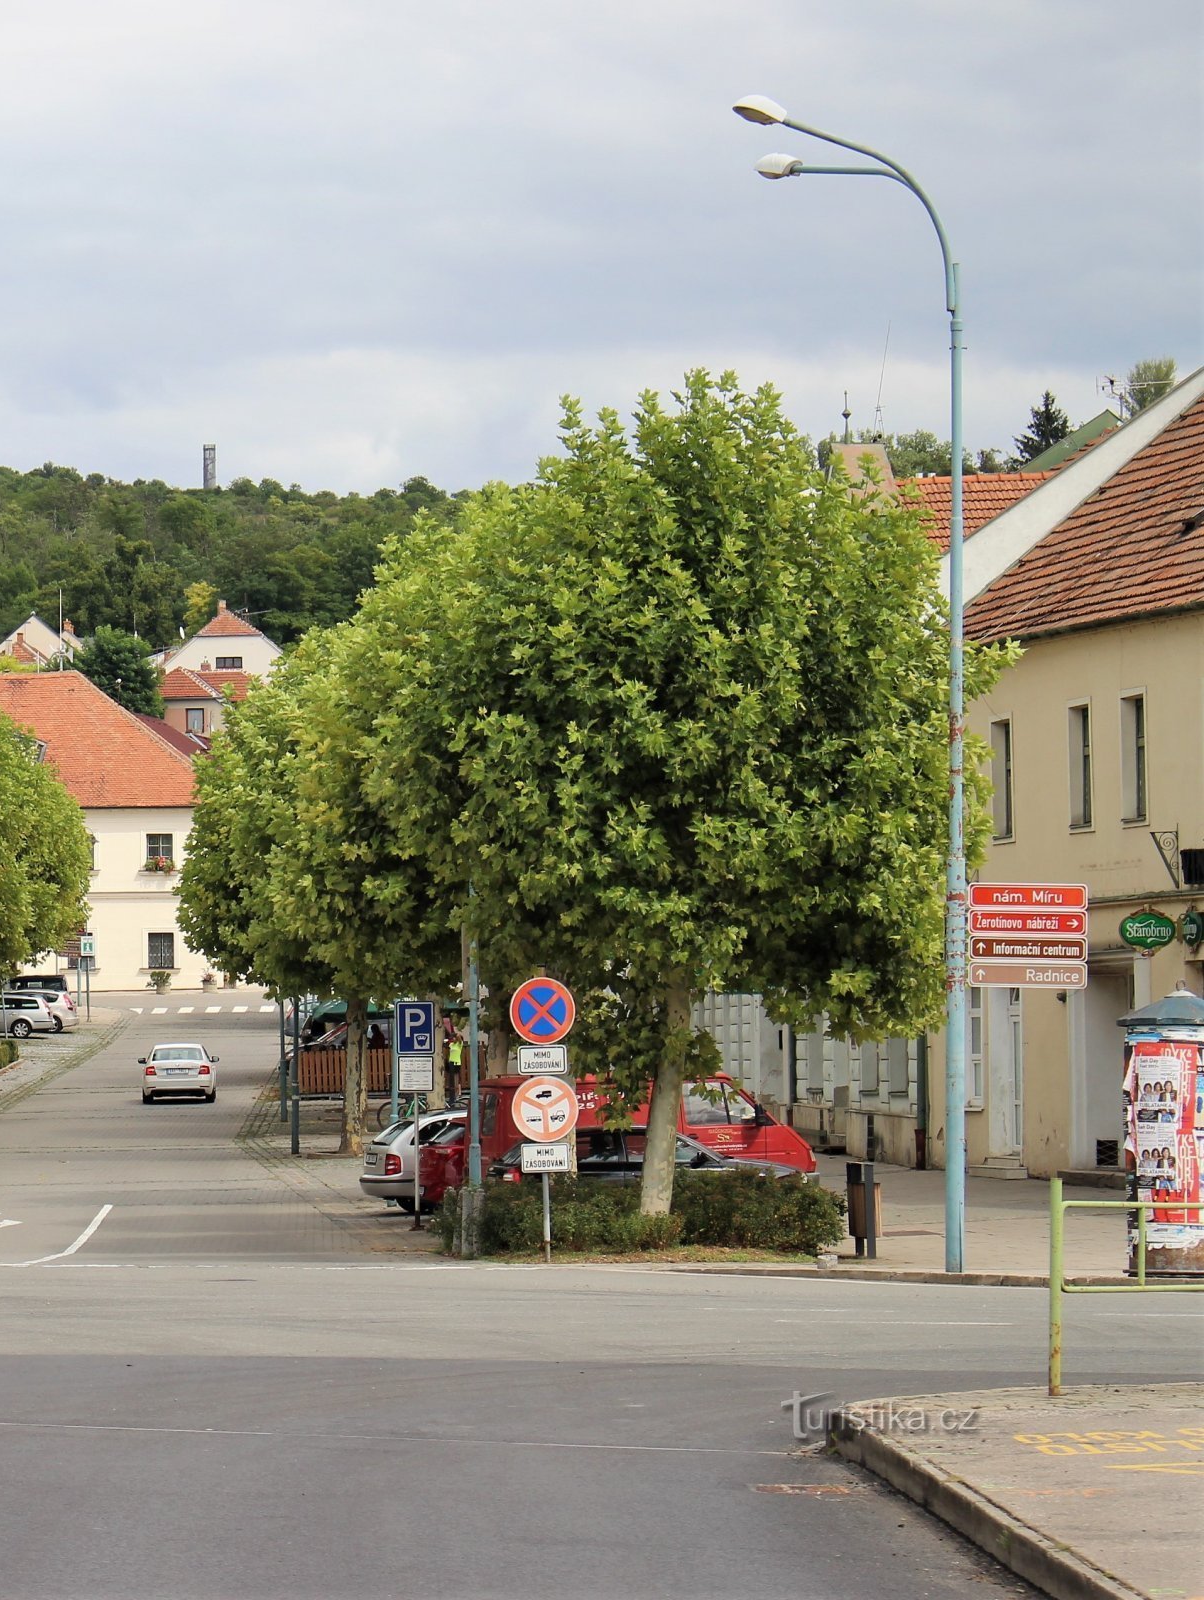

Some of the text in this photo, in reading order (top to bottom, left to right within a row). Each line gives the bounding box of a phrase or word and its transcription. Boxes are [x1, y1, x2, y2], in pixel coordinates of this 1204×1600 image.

[992, 890, 1063, 903] nám. Míru
[976, 912, 1059, 930] Žerotínovo nábřeží
[1126, 920, 1172, 943] Starobrno
[993, 942, 1080, 956] Informační centrum
[1026, 968, 1080, 983] Radnice
[404, 1008, 426, 1038] P
[533, 1050, 551, 1060] MIMO
[523, 1059, 562, 1070] ZÁSOBOVÁNÍ
[536, 1147, 555, 1157] MIMO
[525, 1157, 567, 1169] ZÁSOBOVÁNÍ
